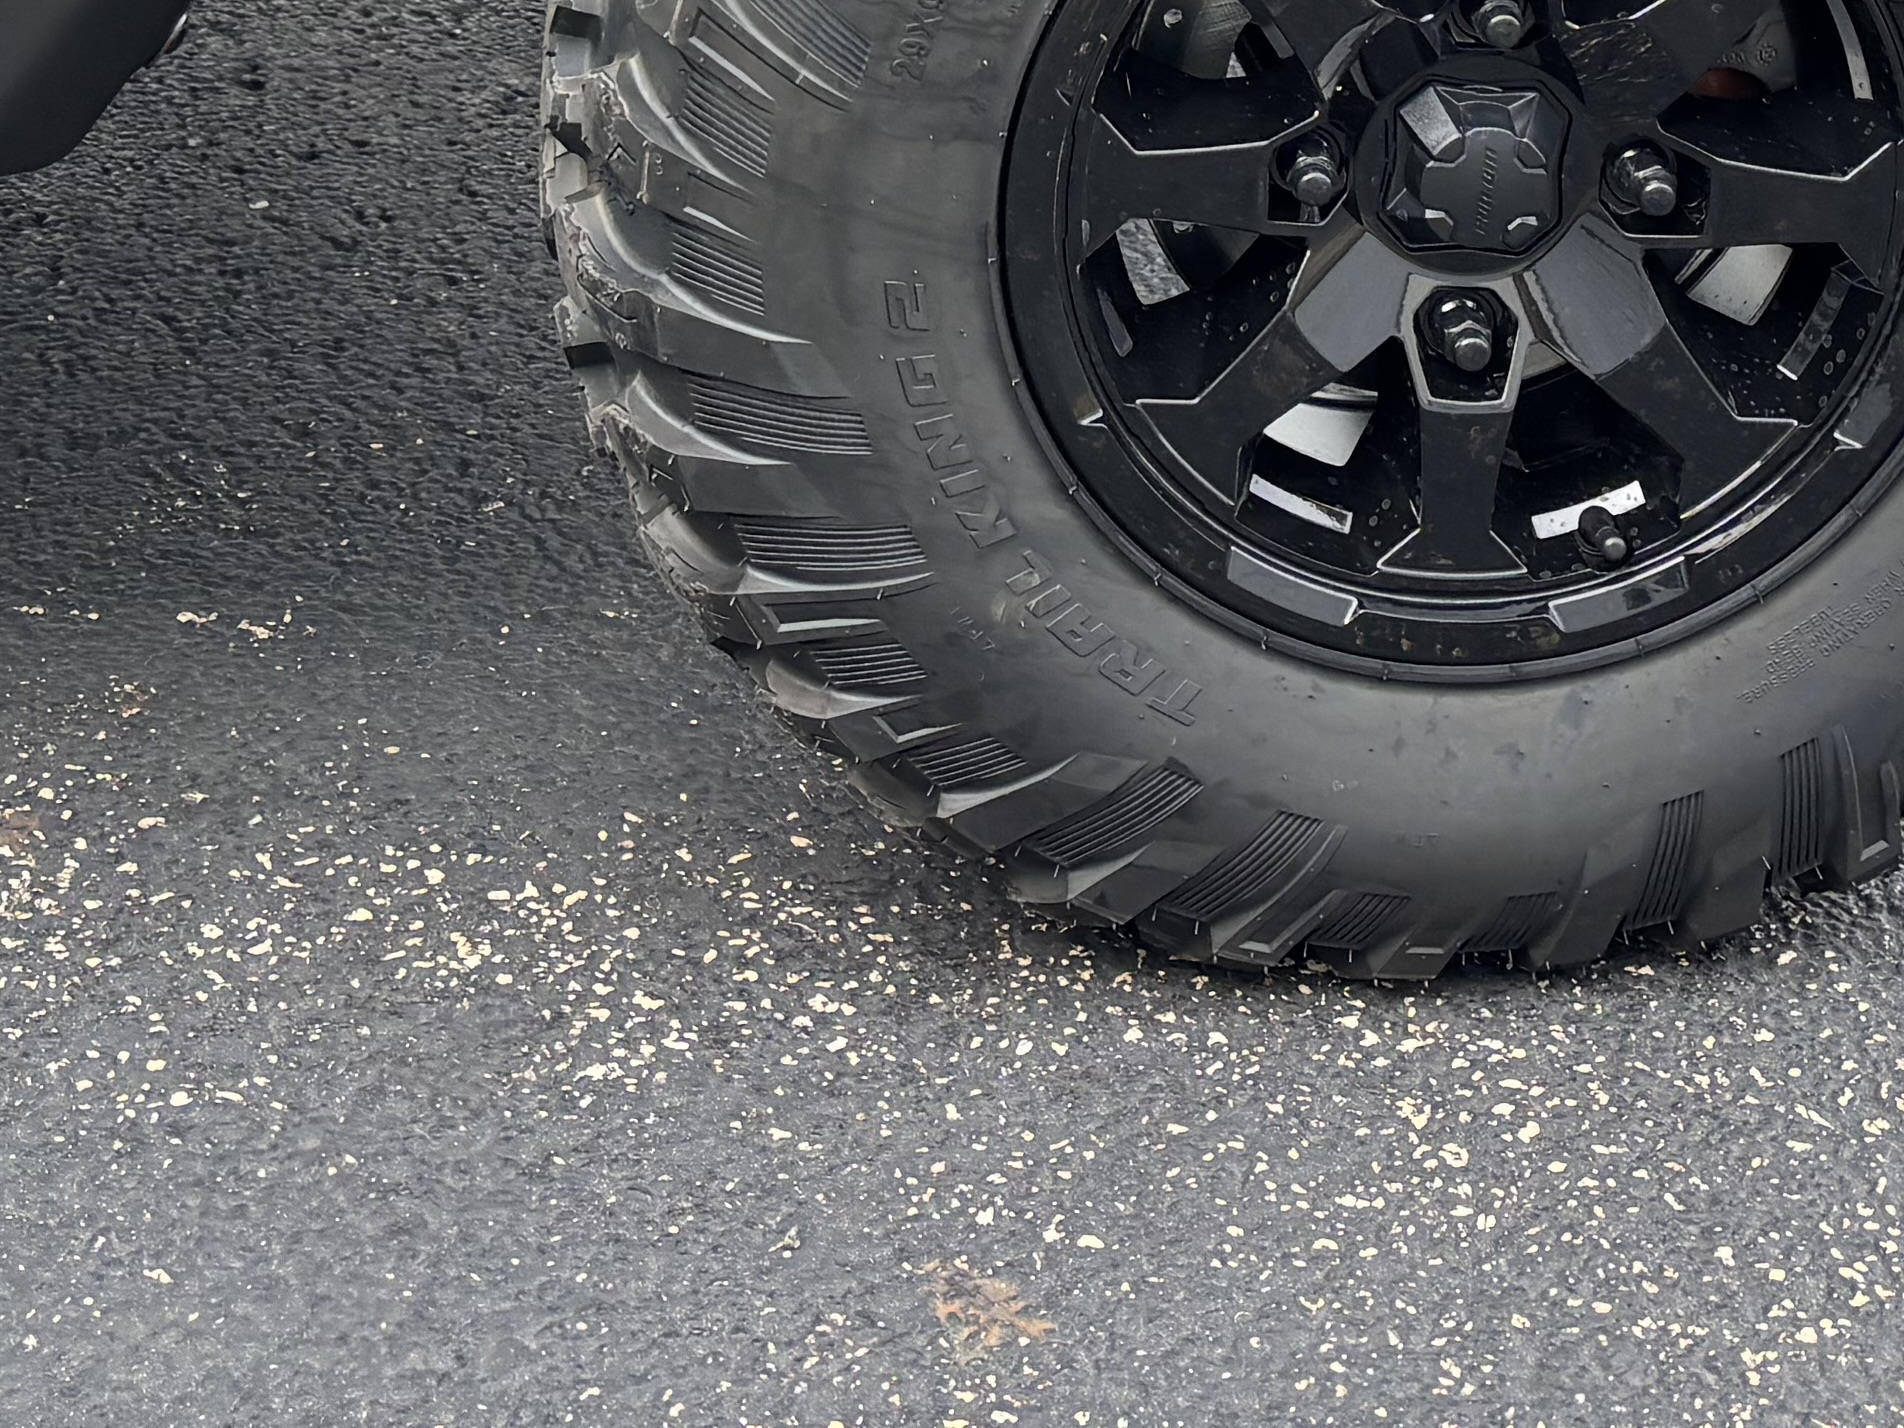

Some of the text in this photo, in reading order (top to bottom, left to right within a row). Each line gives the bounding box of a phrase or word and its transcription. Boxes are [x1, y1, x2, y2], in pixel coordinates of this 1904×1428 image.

[883, 279, 931, 332] 2
[895, 353, 1017, 549] KING
[1005, 549, 1203, 727] TRAIL
